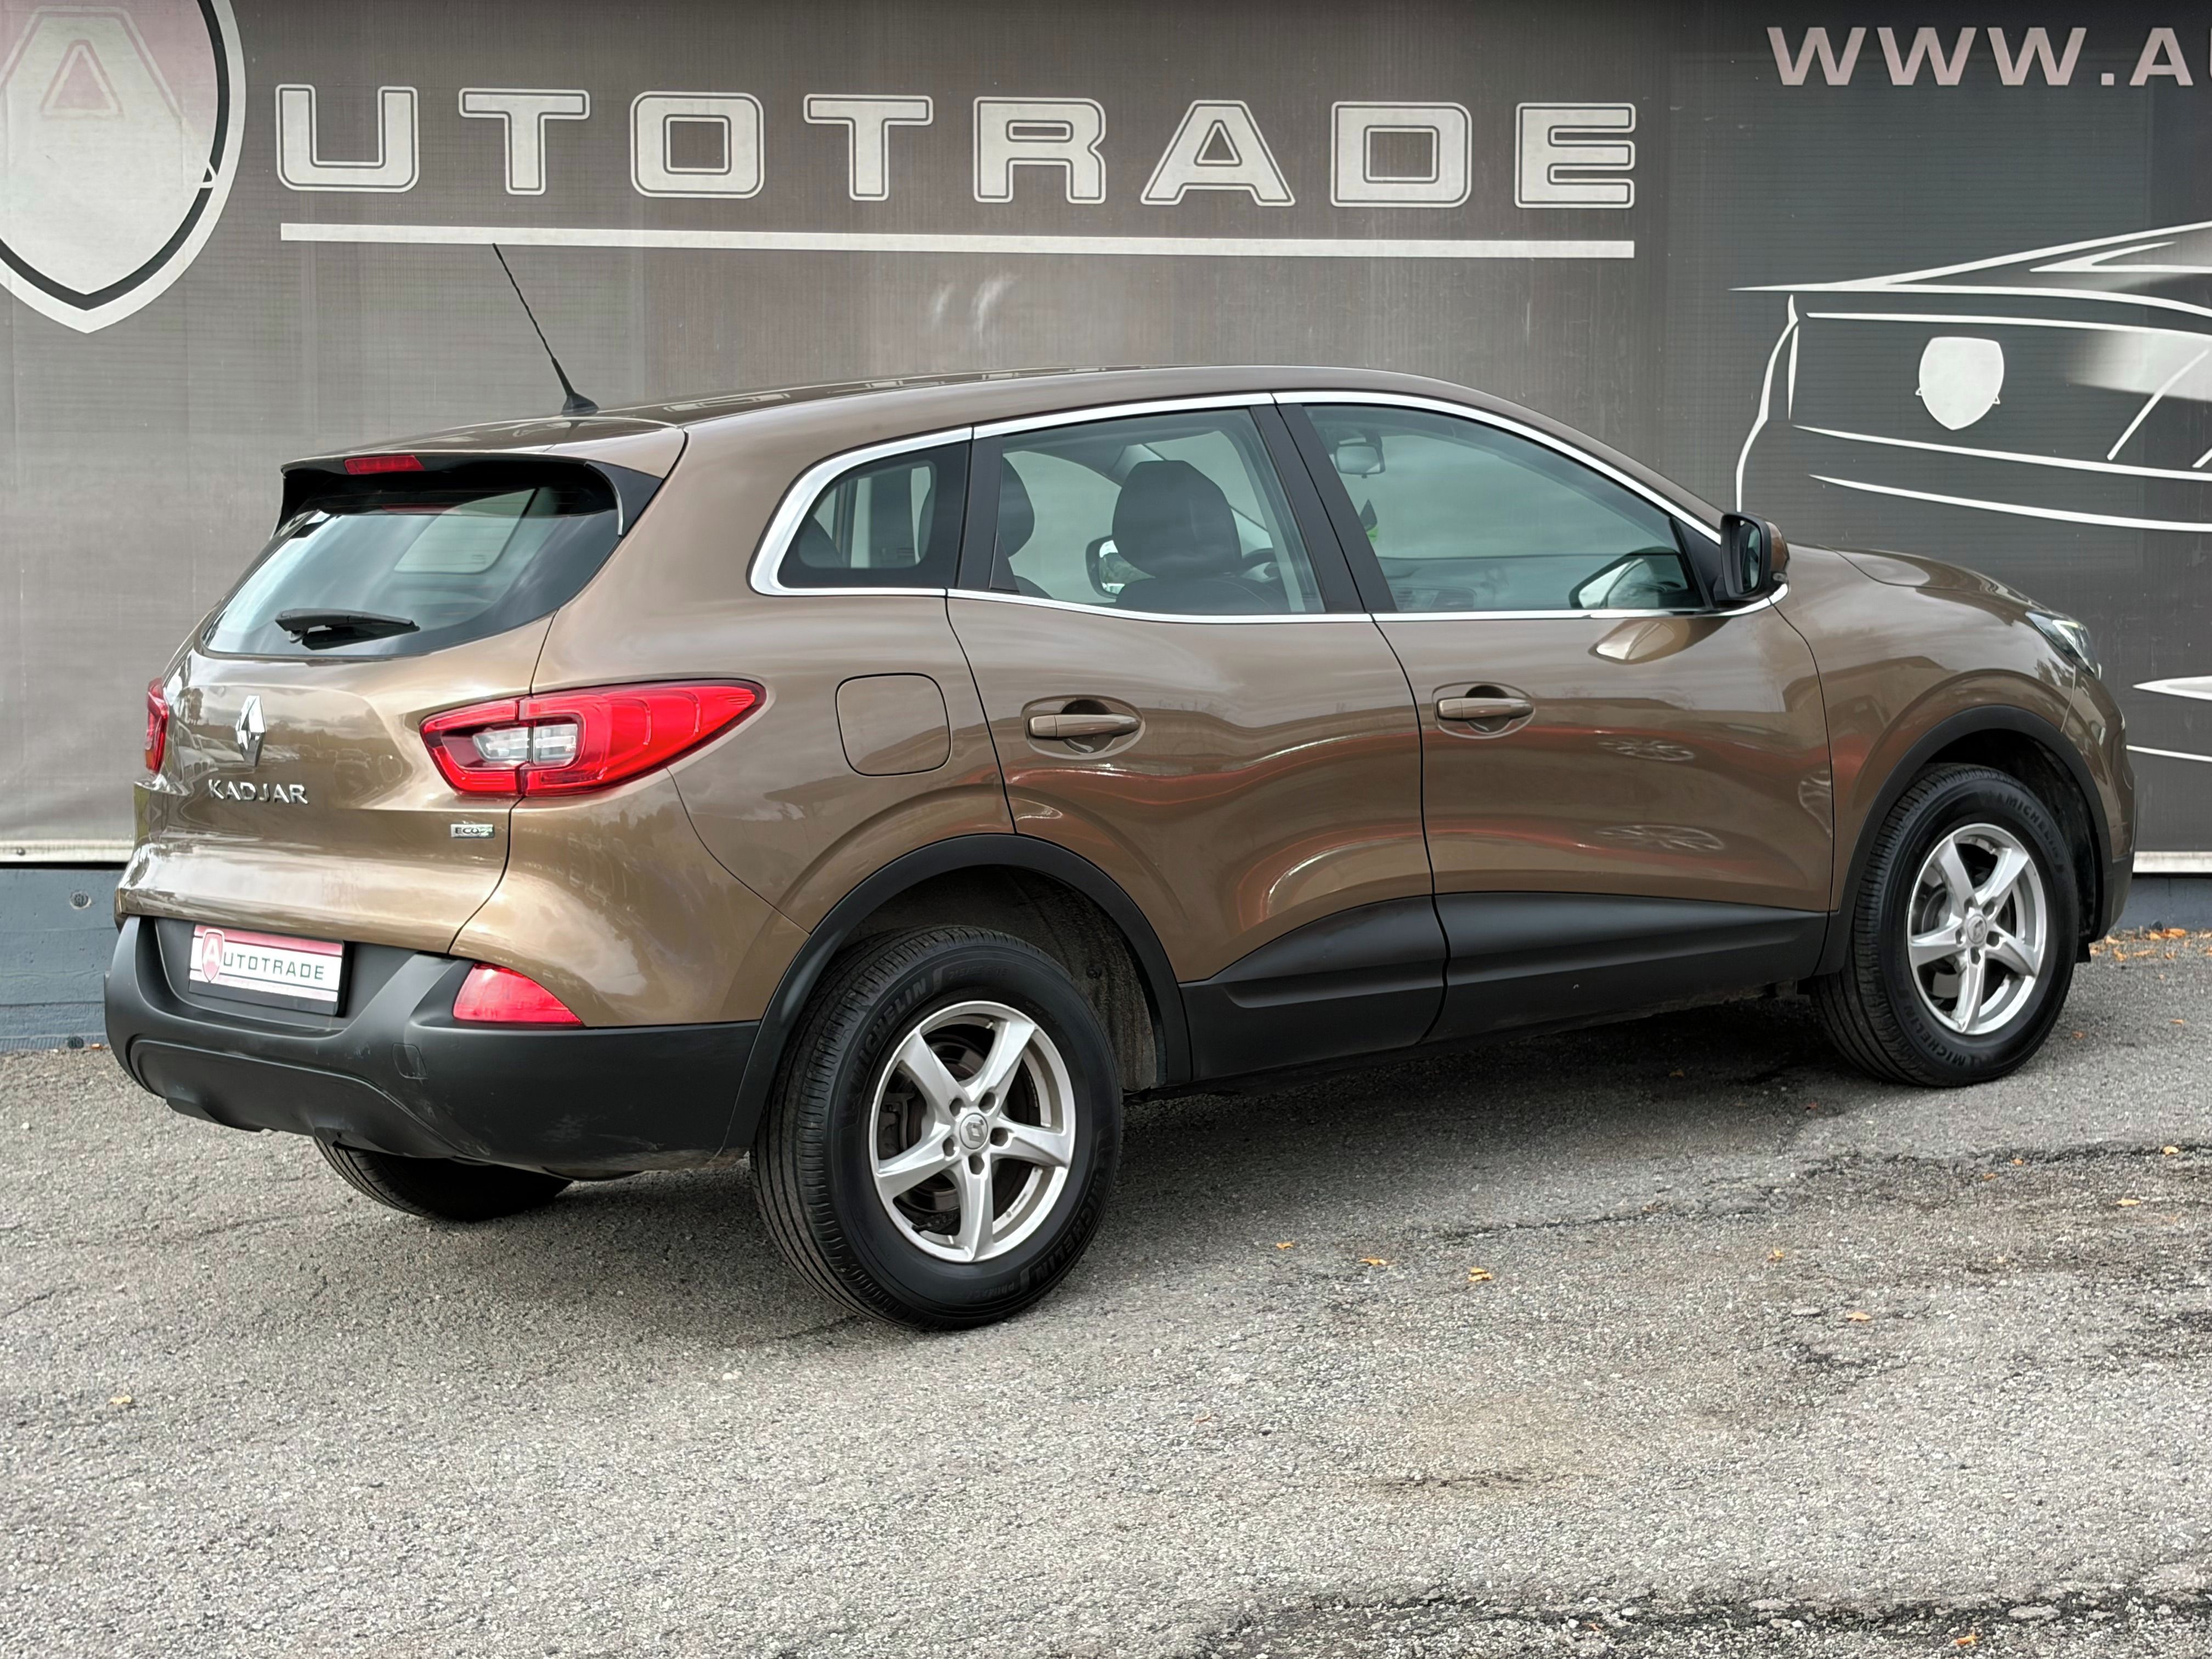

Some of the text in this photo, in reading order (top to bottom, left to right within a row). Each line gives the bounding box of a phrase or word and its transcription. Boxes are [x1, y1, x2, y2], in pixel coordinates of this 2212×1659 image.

[1767, 26, 2212, 86] WWW.A
[208, 778, 309, 804] KADJAR
[204, 938, 324, 980] AUTOTRADE
[850, 978, 927, 1087] MICHELIN
[1904, 1005, 1967, 1066] MICHELIN
[1034, 1166, 1108, 1281] MICHELIN
